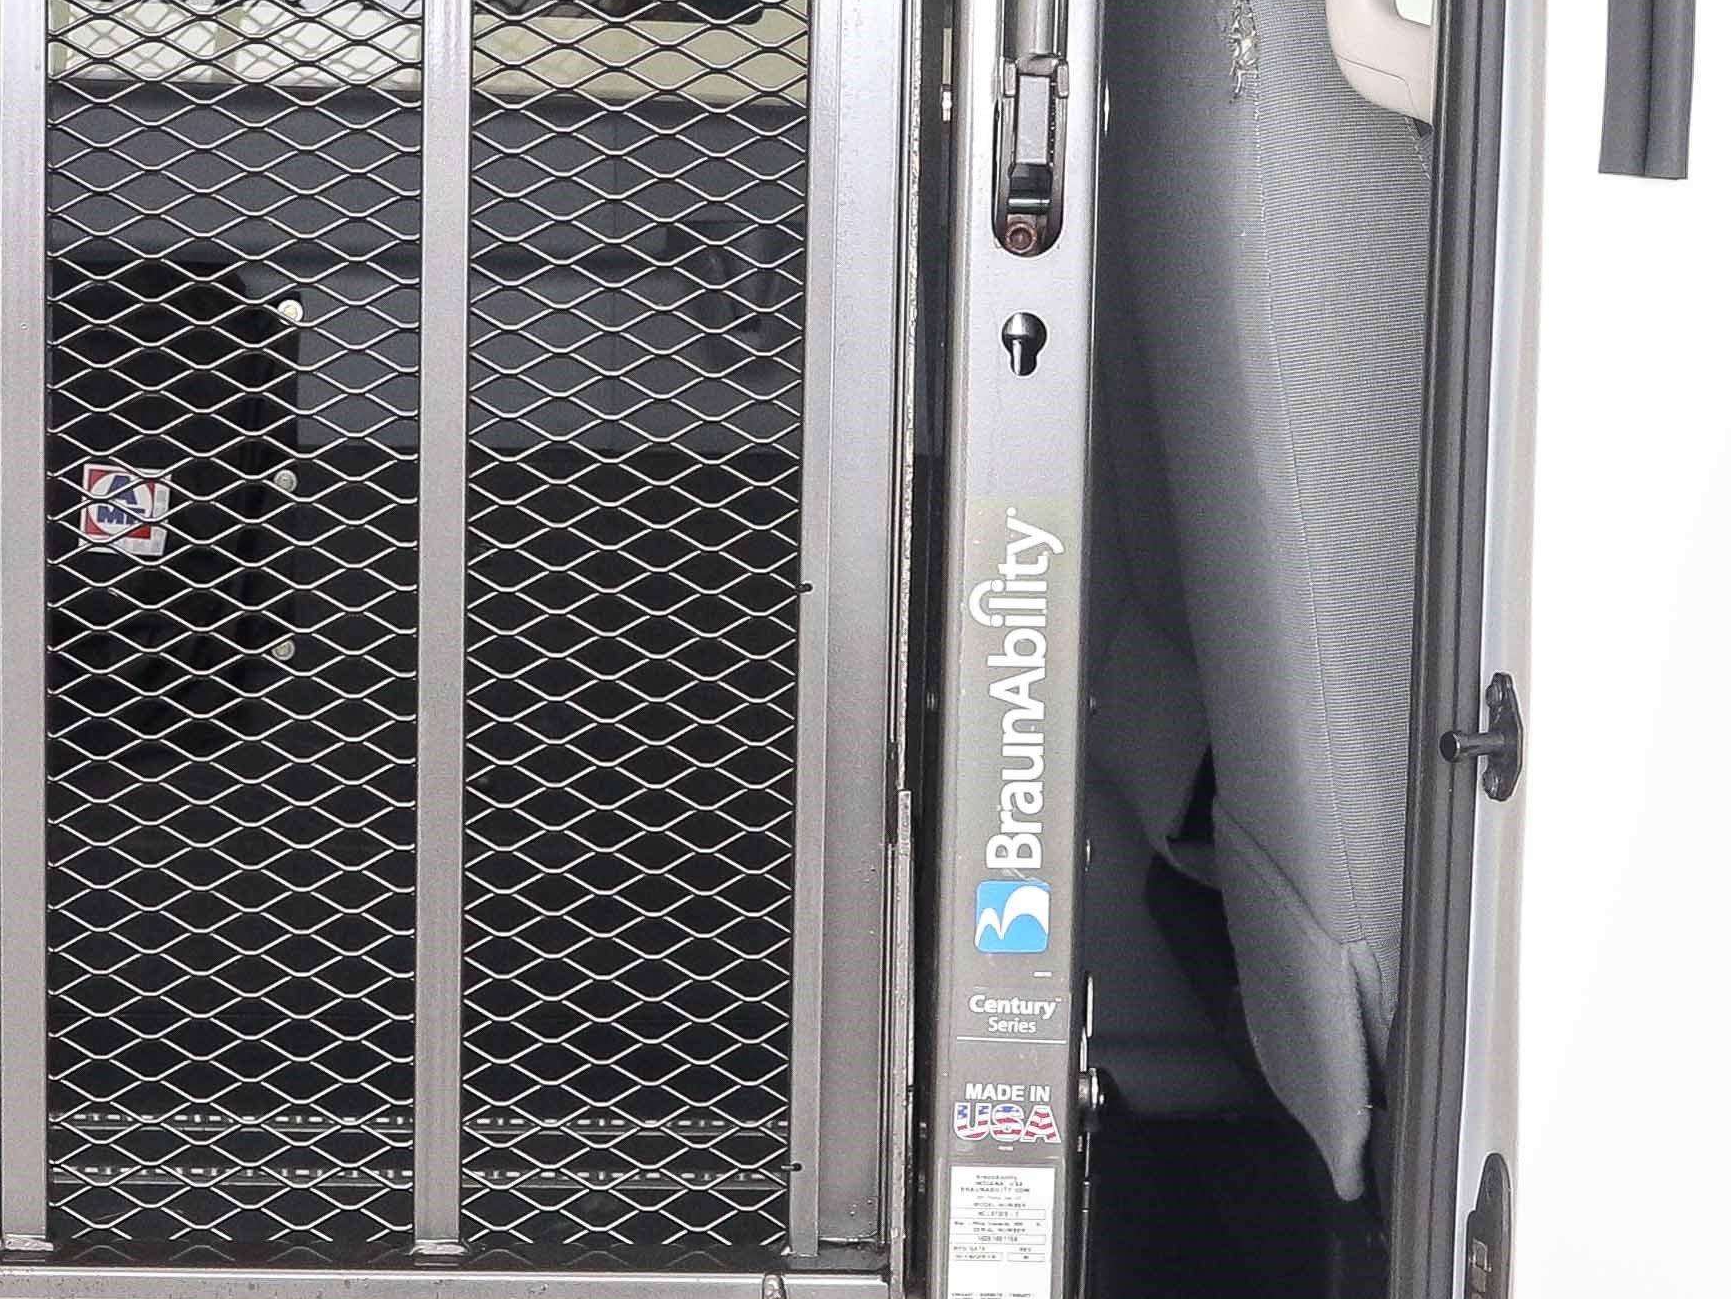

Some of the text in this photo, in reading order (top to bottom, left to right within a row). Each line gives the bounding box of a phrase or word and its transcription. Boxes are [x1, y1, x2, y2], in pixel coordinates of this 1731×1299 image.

[970, 515, 1065, 870] BraunAbility
[969, 994, 1057, 1019] Century
[987, 1017, 1037, 1034] Series
[965, 1082, 1050, 1102] MADE IN
[952, 1102, 1062, 1144] USA
